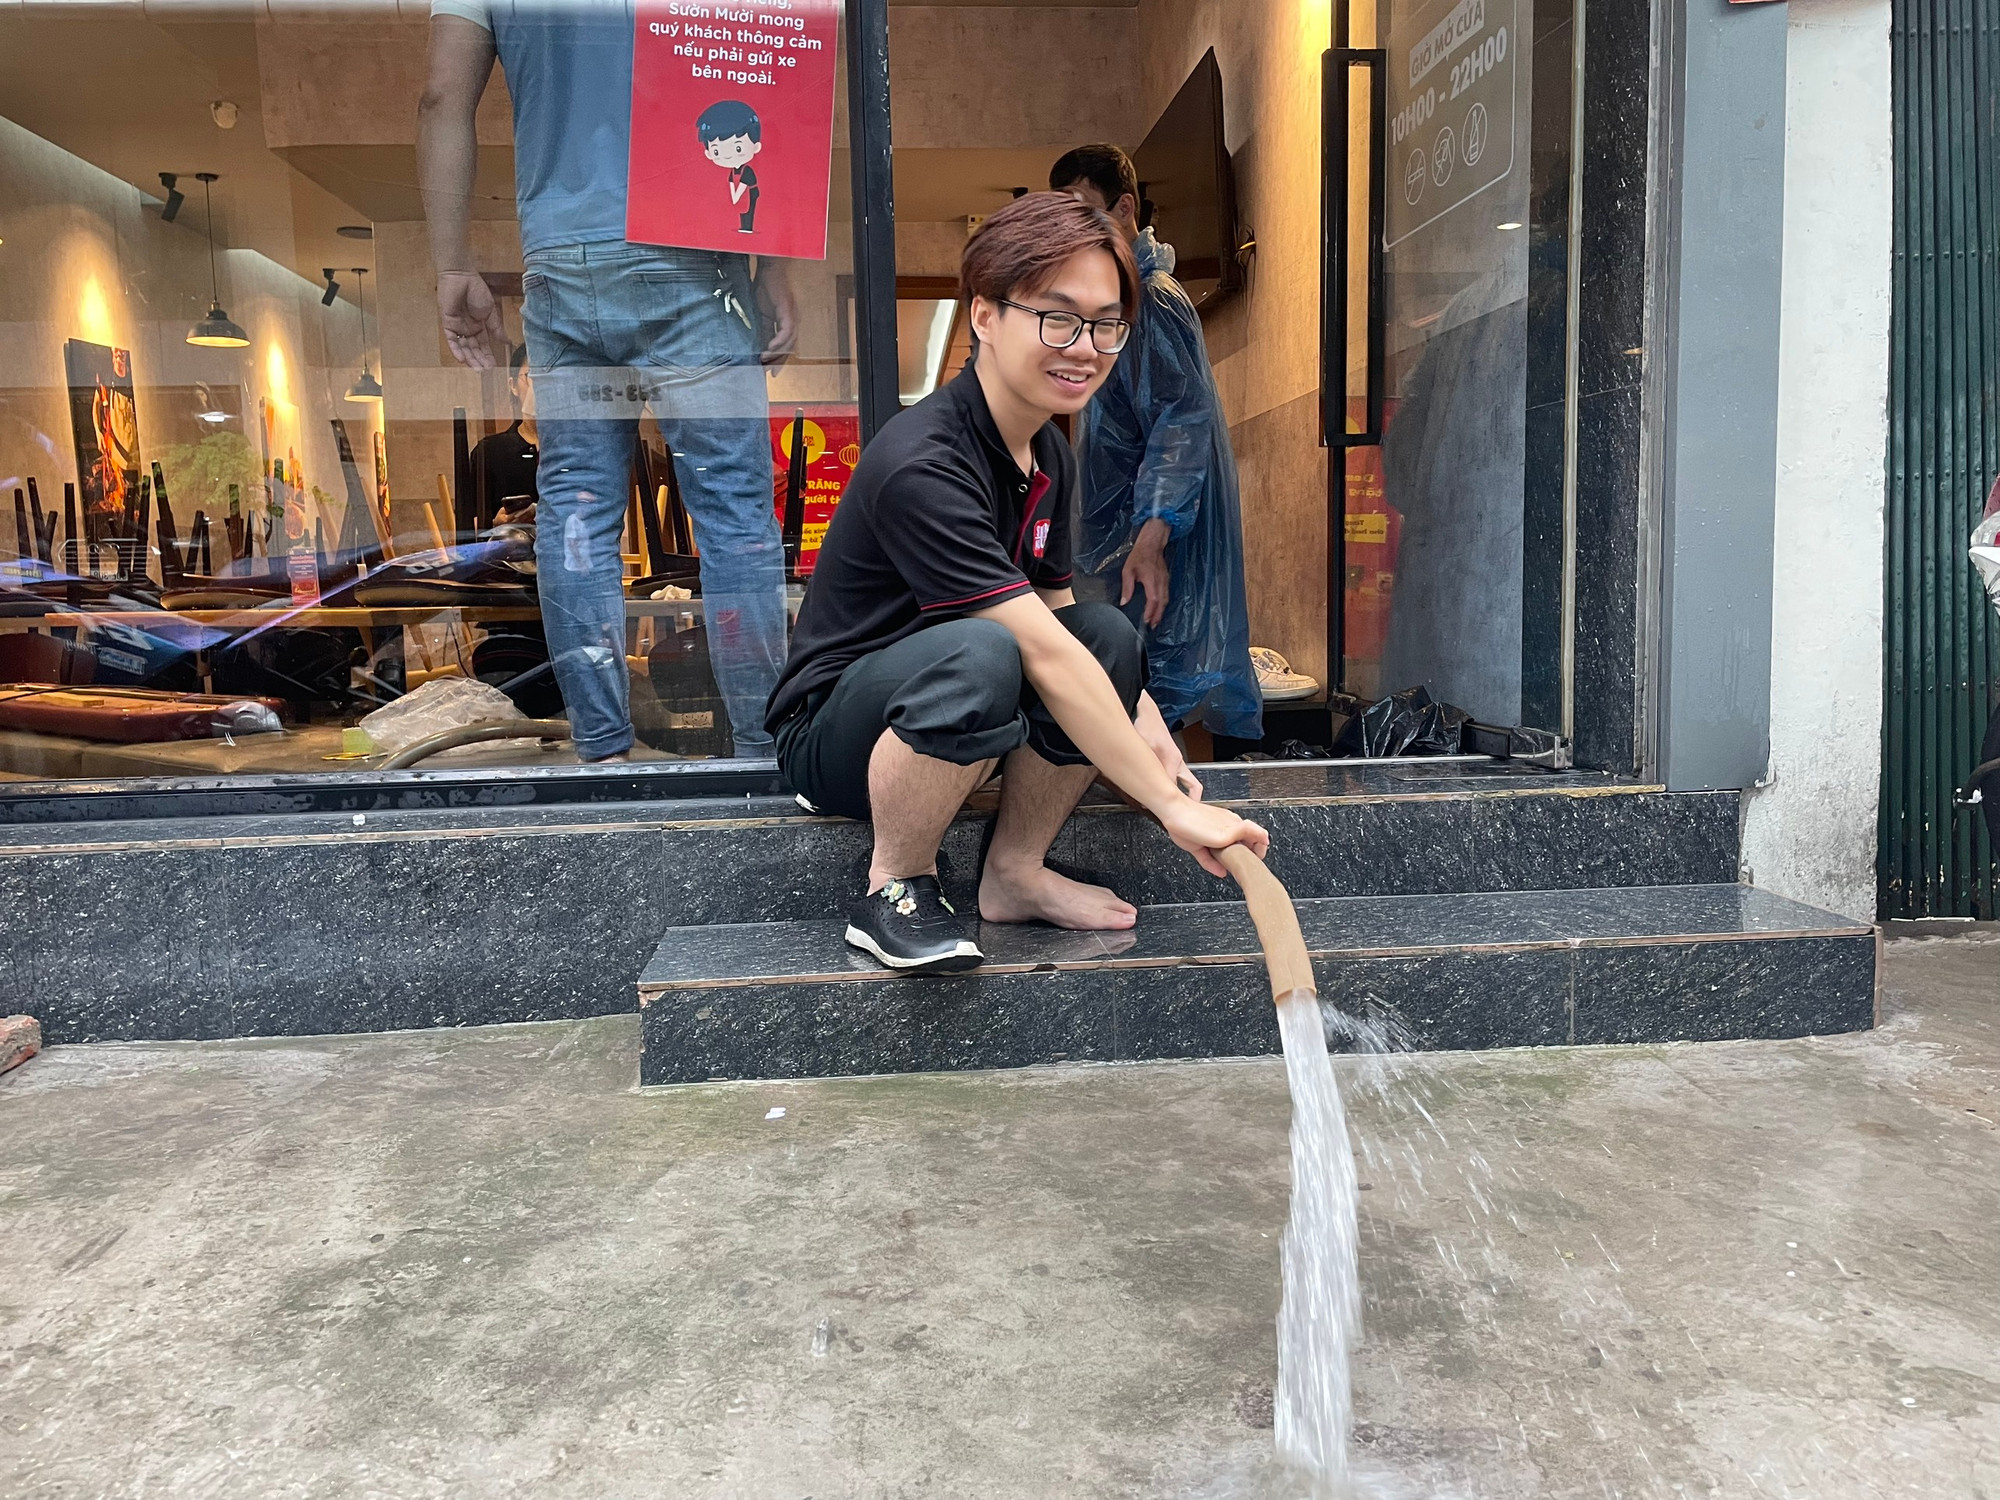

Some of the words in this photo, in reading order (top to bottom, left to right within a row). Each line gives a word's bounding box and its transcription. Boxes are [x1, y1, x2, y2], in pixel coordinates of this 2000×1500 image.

[669, 3, 710, 18] Sườn
[715, 6, 754, 23] Mười
[759, 14, 805, 31] mong
[649, 21, 679, 37] quý
[684, 23, 732, 41] khách
[737, 29, 784, 48] thông
[789, 34, 822, 50] cảm
[674, 40, 703, 57] nếu
[708, 46, 743, 62] phải
[748, 50, 773, 66] gửi
[778, 55, 797, 67] xe
[1411, 41, 1432, 79] GIỜ
[692, 63, 722, 79] bên
[727, 70, 776, 85] ngoài.
[1391, 87, 1436, 146] 10H00
[1450, 26, 1507, 101] 22H00
